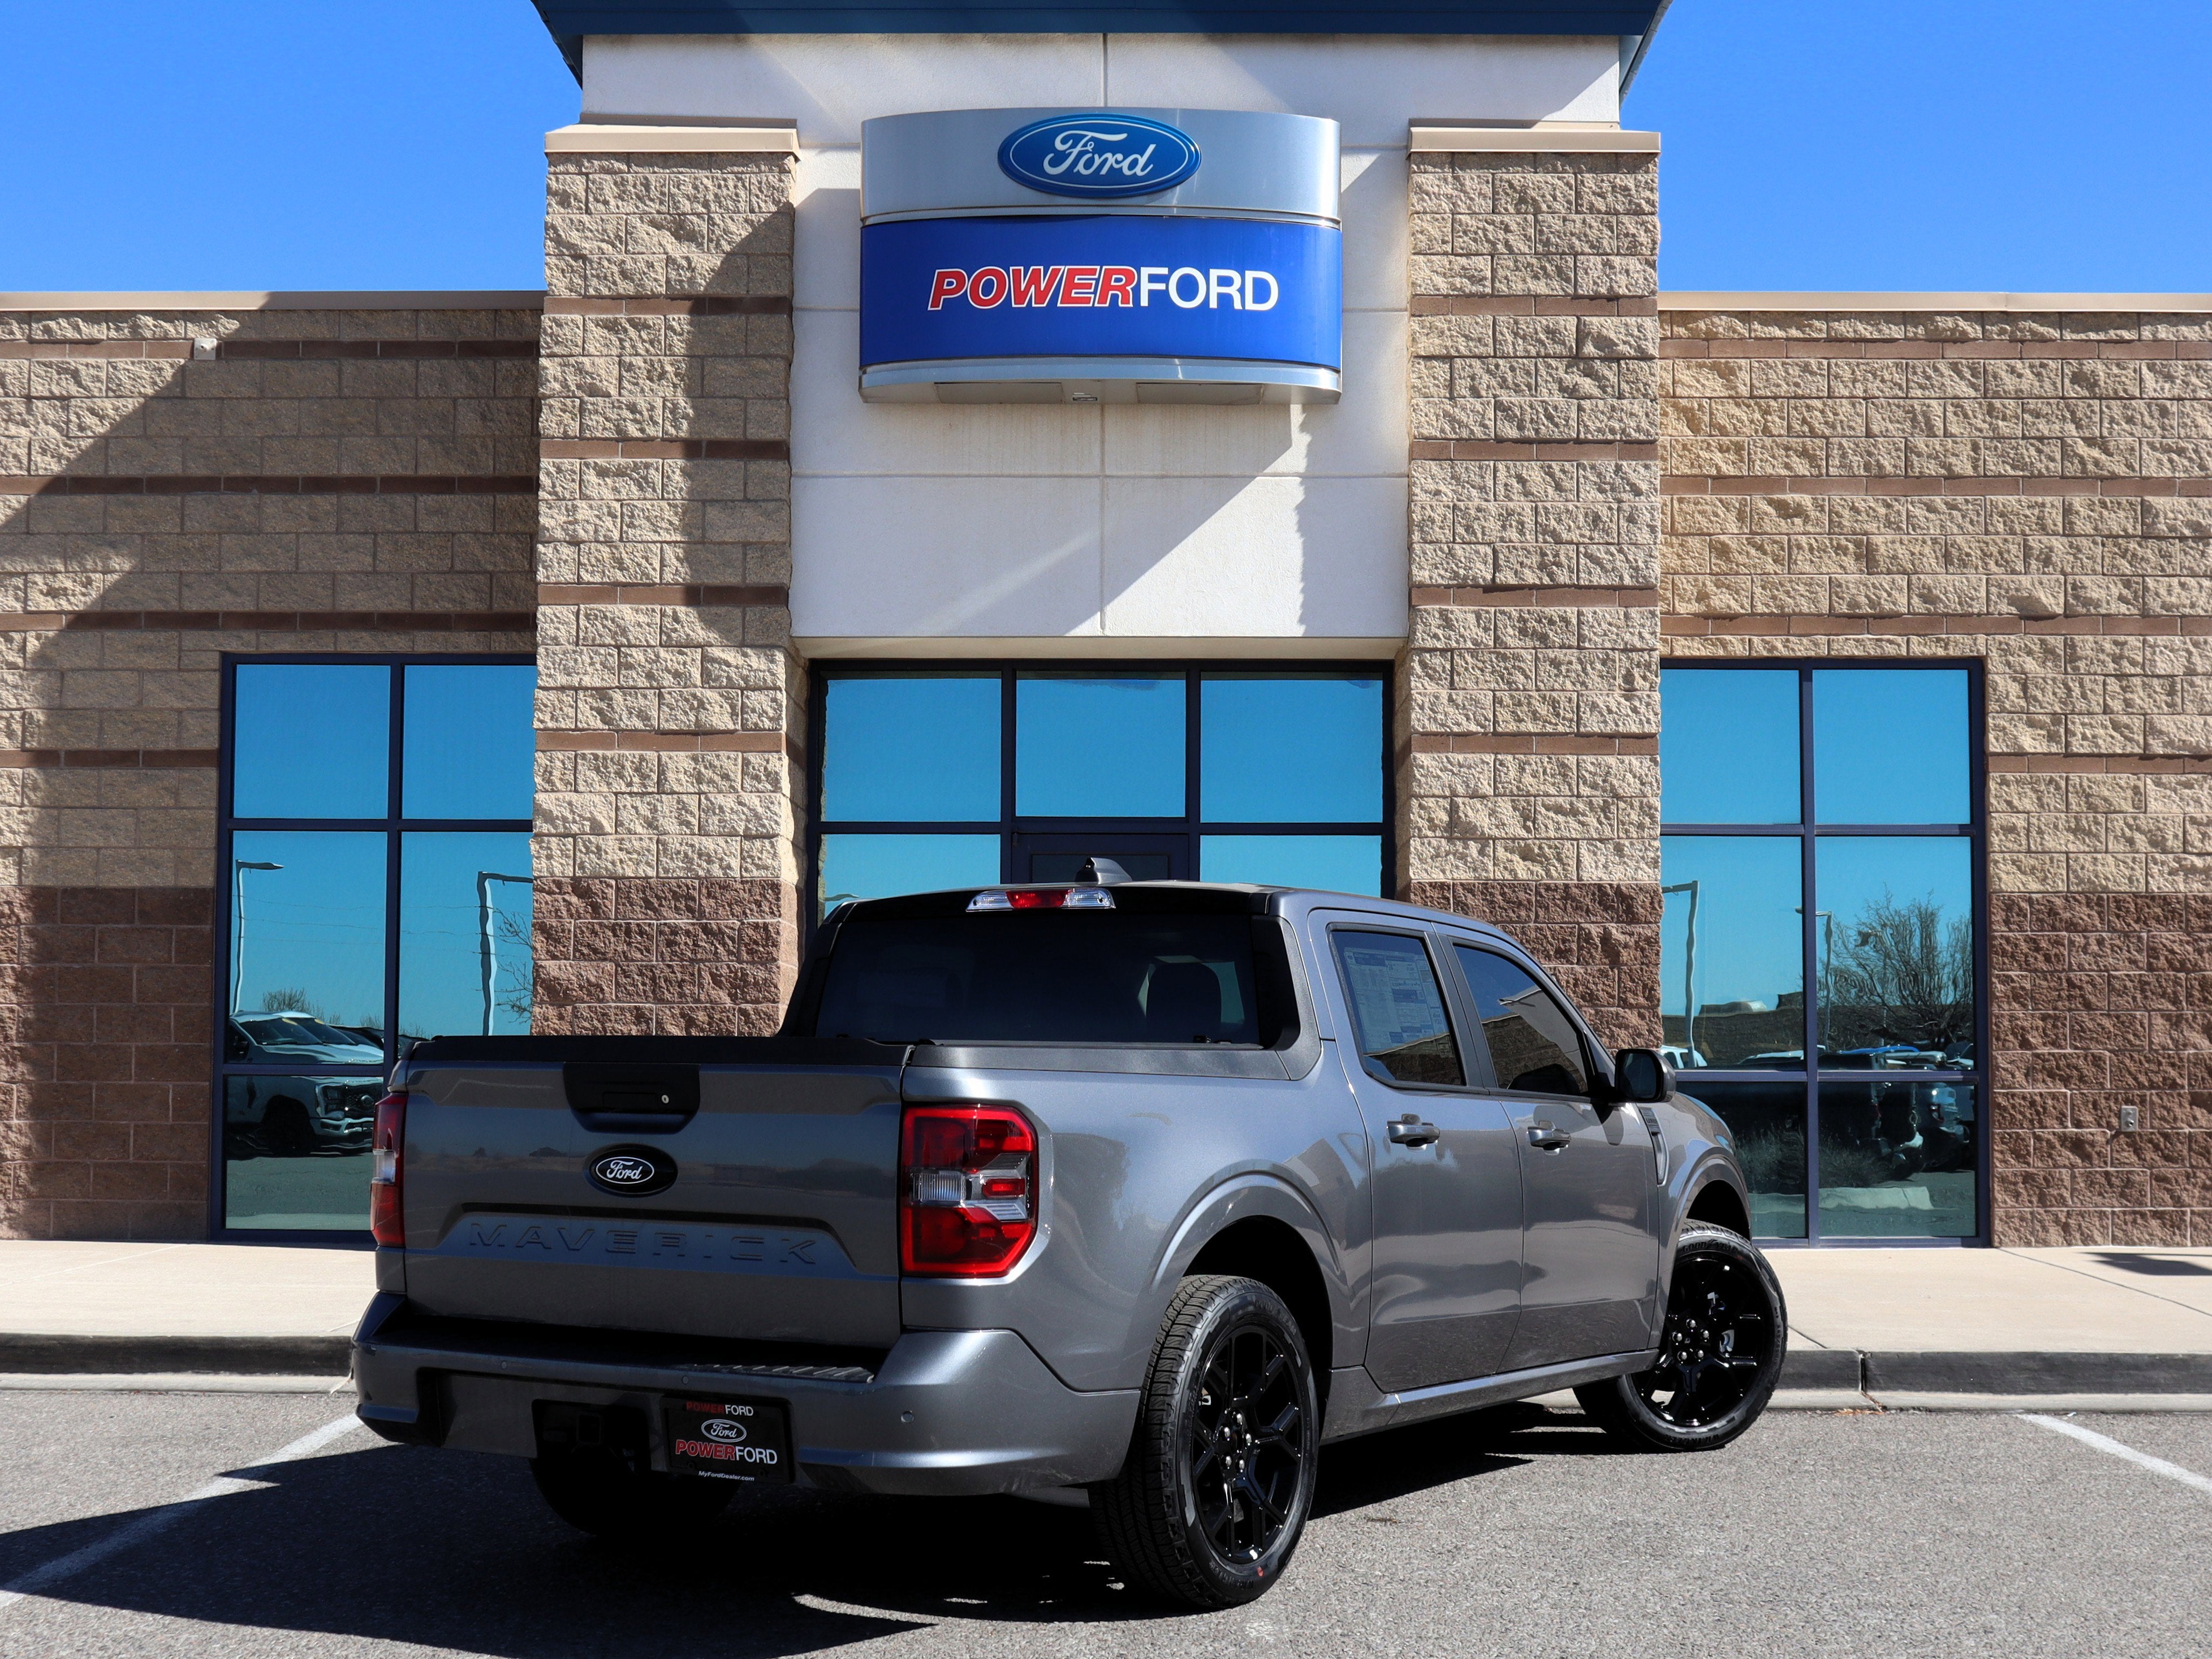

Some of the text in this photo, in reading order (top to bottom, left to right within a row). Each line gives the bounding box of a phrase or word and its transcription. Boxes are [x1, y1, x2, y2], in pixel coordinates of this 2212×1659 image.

[1043, 130, 1156, 176] Ford
[928, 266, 1279, 311] POWERFORD
[607, 1160, 643, 1181] Ford
[470, 1224, 816, 1263] MAVERICK
[686, 1402, 754, 1416] POWERFORD
[711, 1423, 738, 1438] Ford
[676, 1440, 777, 1464] POWERFORD
[699, 1471, 755, 1481] MyFordDealer.com
